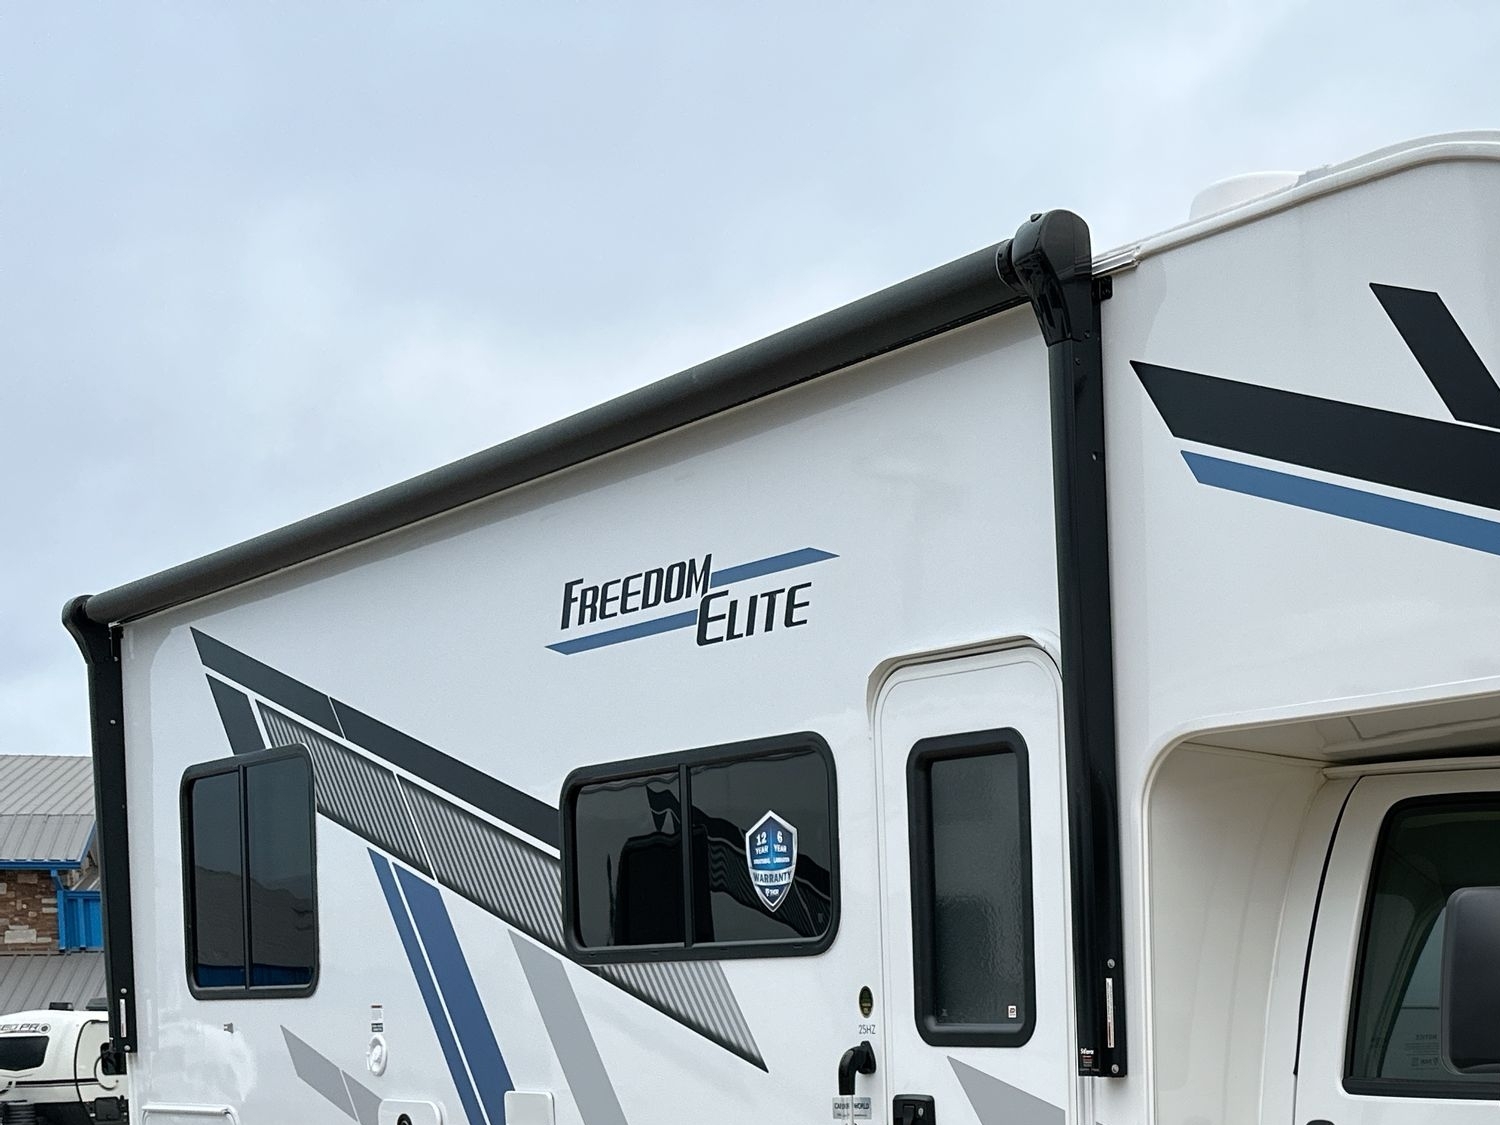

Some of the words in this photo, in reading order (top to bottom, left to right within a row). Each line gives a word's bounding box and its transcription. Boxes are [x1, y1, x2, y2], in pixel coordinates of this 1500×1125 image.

[560, 553, 713, 630] FREEDOM
[696, 581, 813, 647] ELITE
[756, 831, 768, 846] 12
[776, 830, 783, 844] 6
[755, 845, 769, 856] YEAR
[773, 843, 788, 854] YEAR
[753, 871, 791, 884] WARRANTY
[858, 1024, 876, 1035] 25HZ
